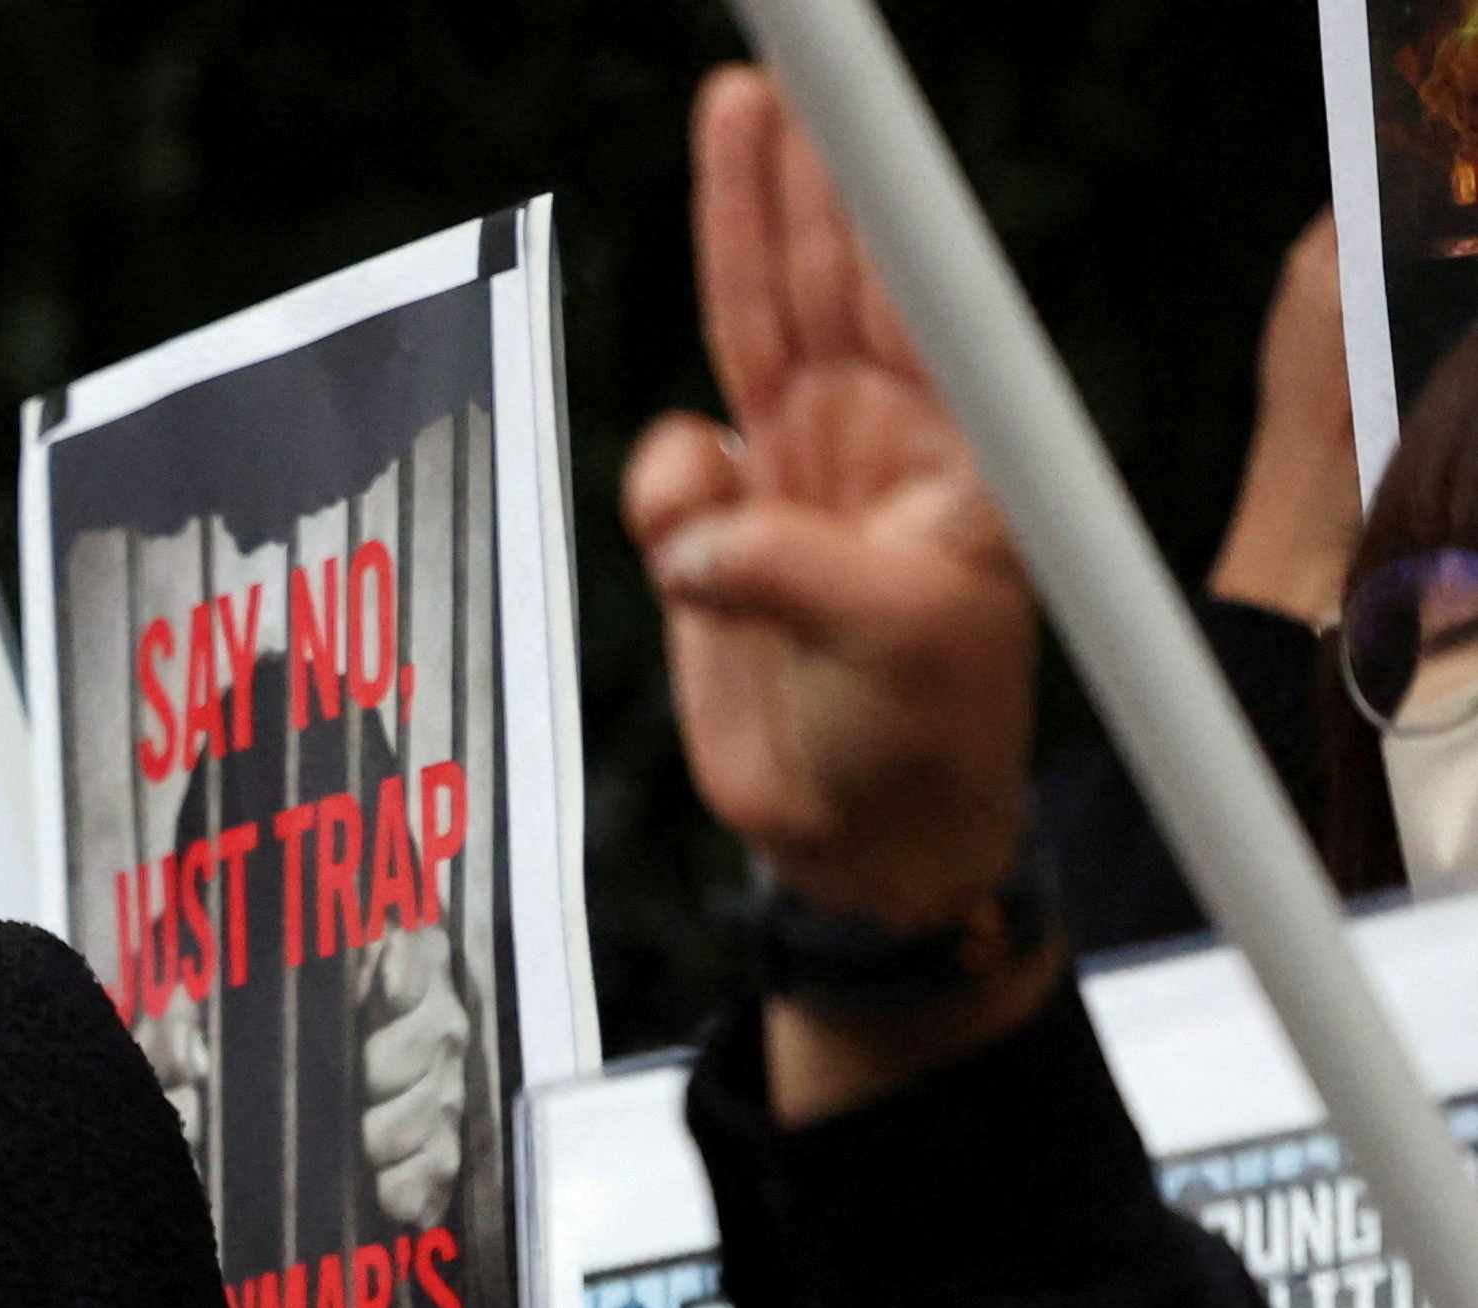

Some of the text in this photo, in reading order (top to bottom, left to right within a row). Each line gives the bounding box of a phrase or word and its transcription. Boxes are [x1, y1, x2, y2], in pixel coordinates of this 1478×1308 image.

[136, 538, 417, 784] SAY NO,
[105, 759, 469, 1028] JUST TRAP
[1200, 1176, 1384, 1280] UNG
